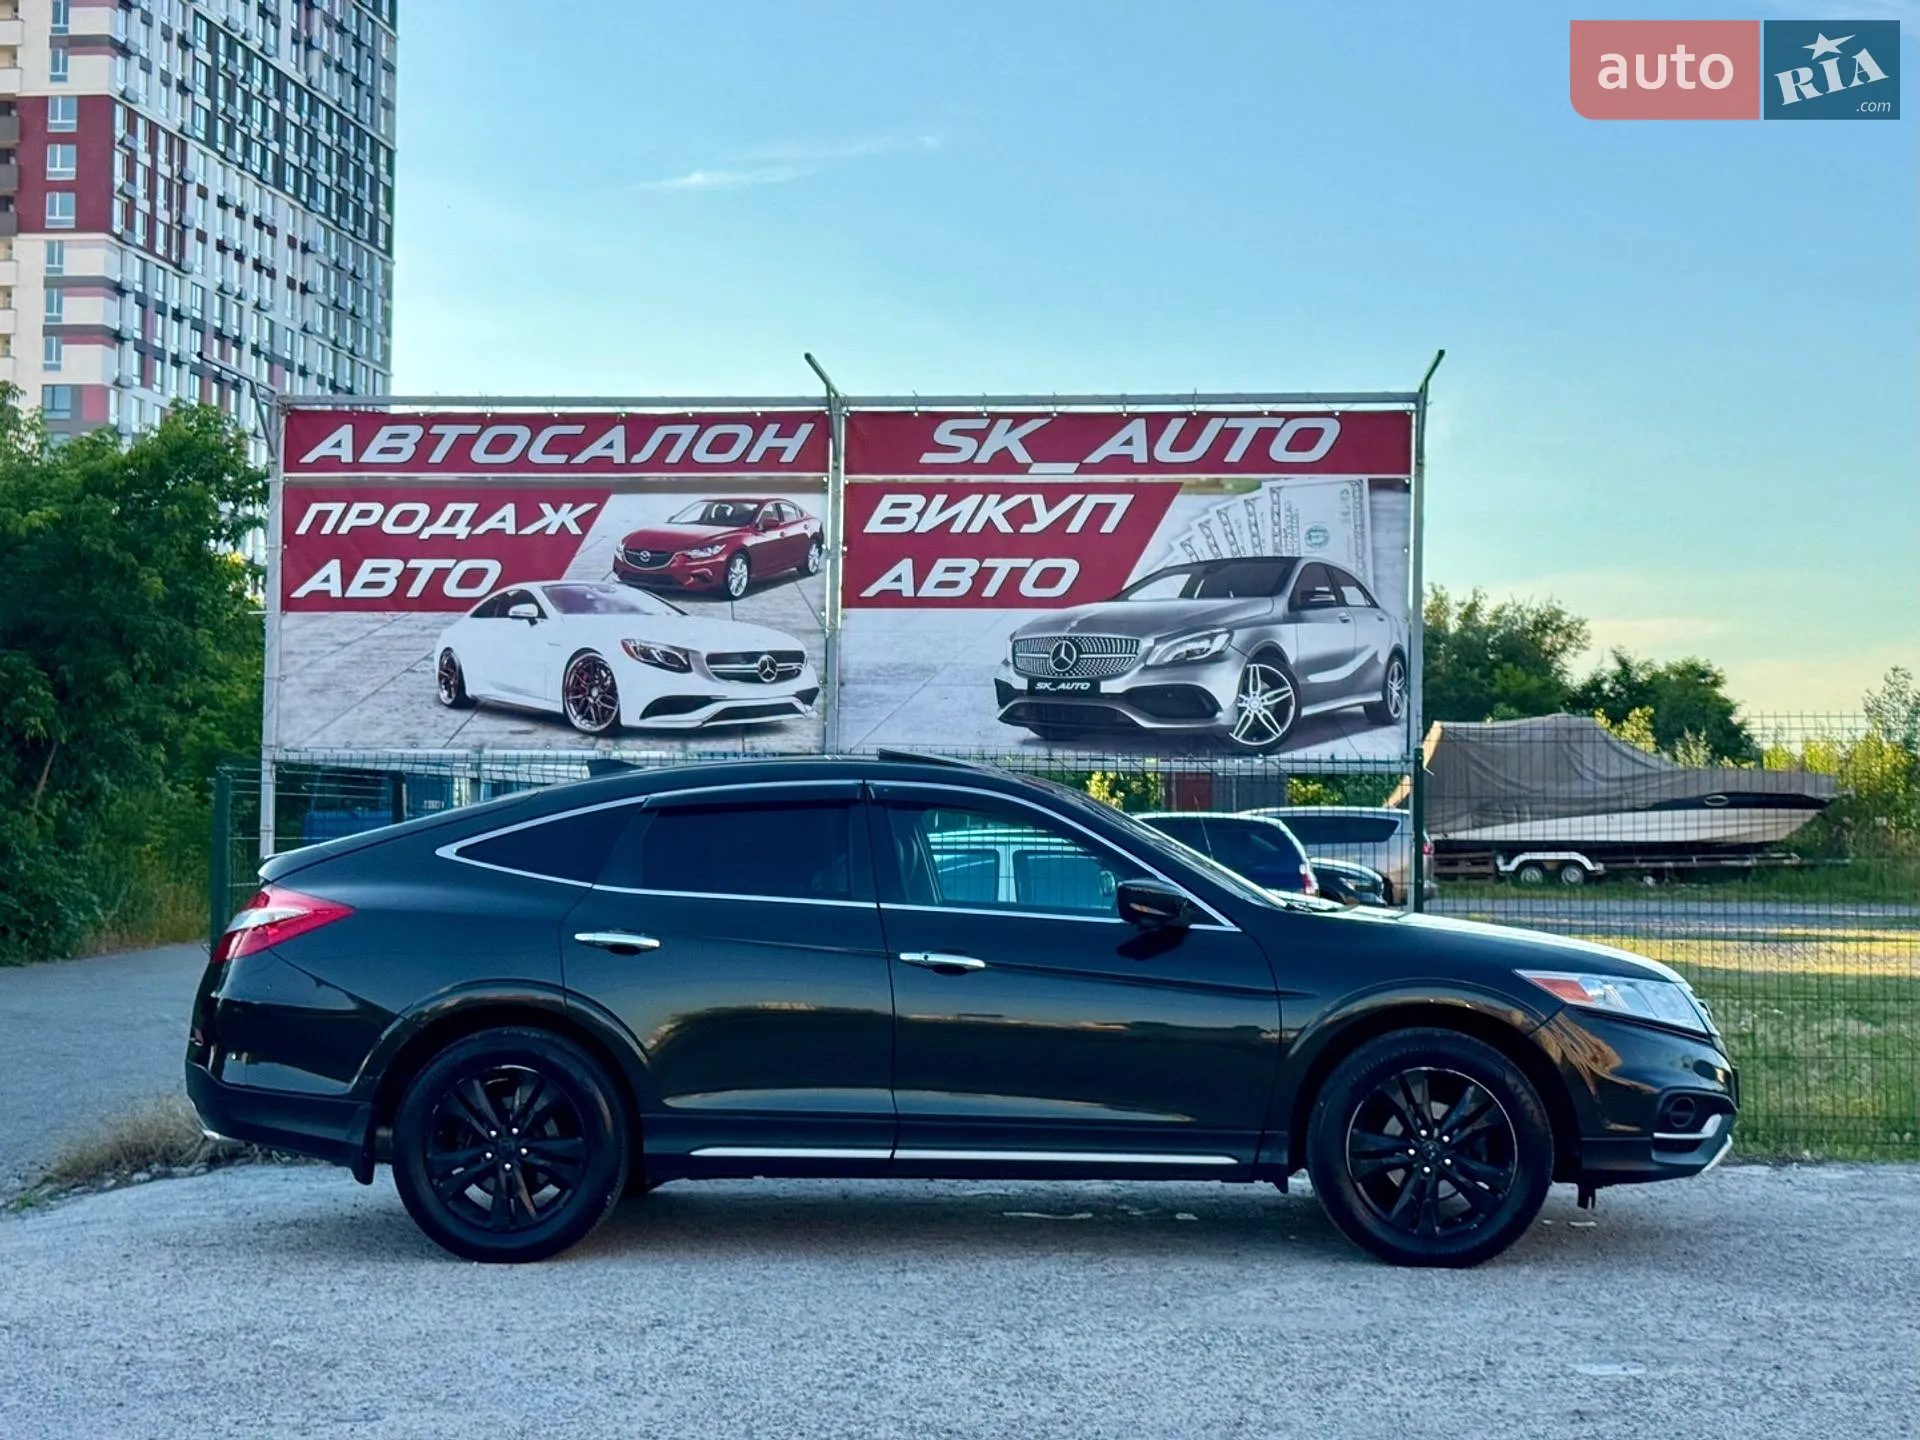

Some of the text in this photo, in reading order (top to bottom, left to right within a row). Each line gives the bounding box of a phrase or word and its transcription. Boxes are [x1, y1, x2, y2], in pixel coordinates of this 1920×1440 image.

[298, 422, 815, 465] АВТОСАЛОН
[917, 416, 1342, 475] SK_AUTO
[294, 500, 599, 541] ПРОДАЖ
[861, 492, 1136, 536] ВИКУП
[288, 556, 504, 600] АВТО
[858, 556, 1082, 599] АВТО
[1034, 681, 1092, 692] SK_AUTO
